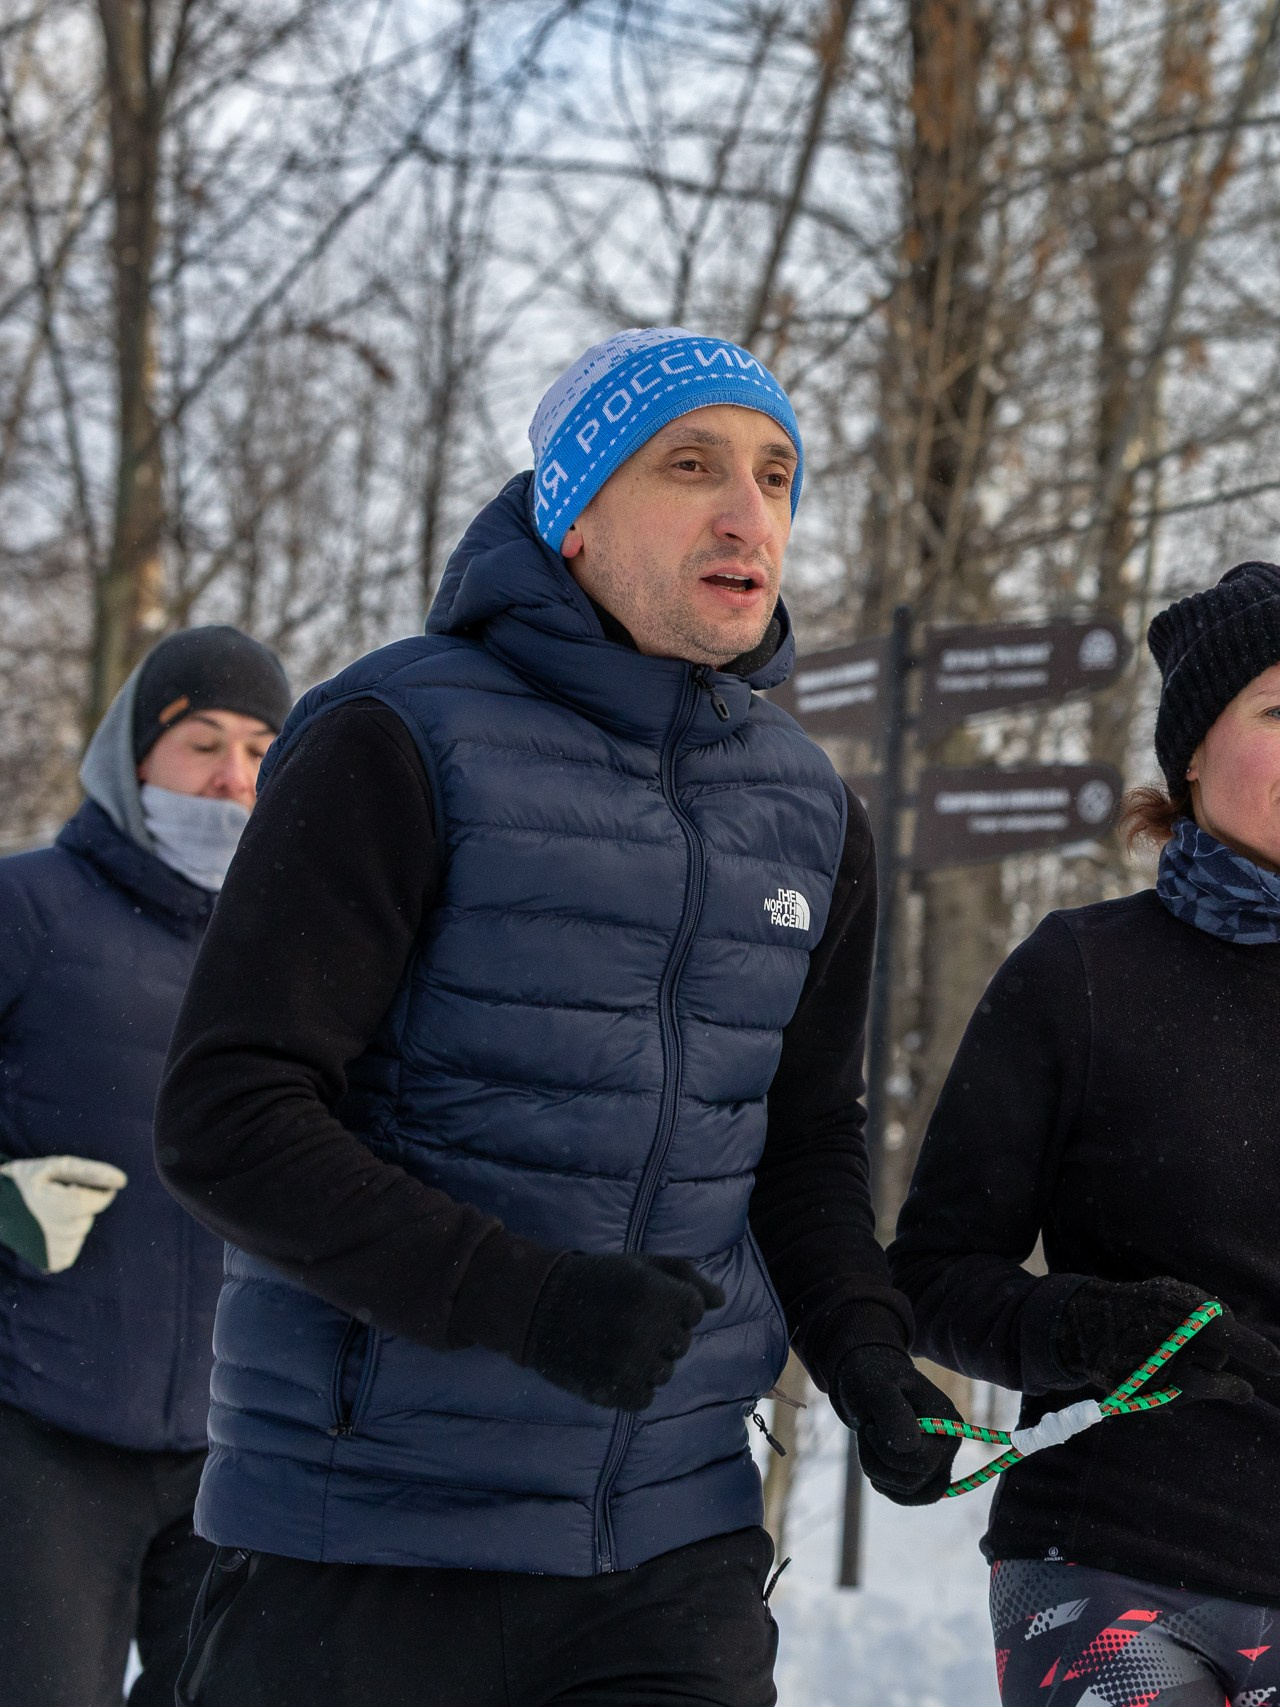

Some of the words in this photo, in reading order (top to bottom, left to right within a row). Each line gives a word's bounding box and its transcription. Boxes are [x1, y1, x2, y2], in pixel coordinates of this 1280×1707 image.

[575, 347, 766, 454] РОССИИ
[778, 888, 796, 902] THE
[763, 898, 796, 916] NORTH
[771, 912, 796, 928] FACE
